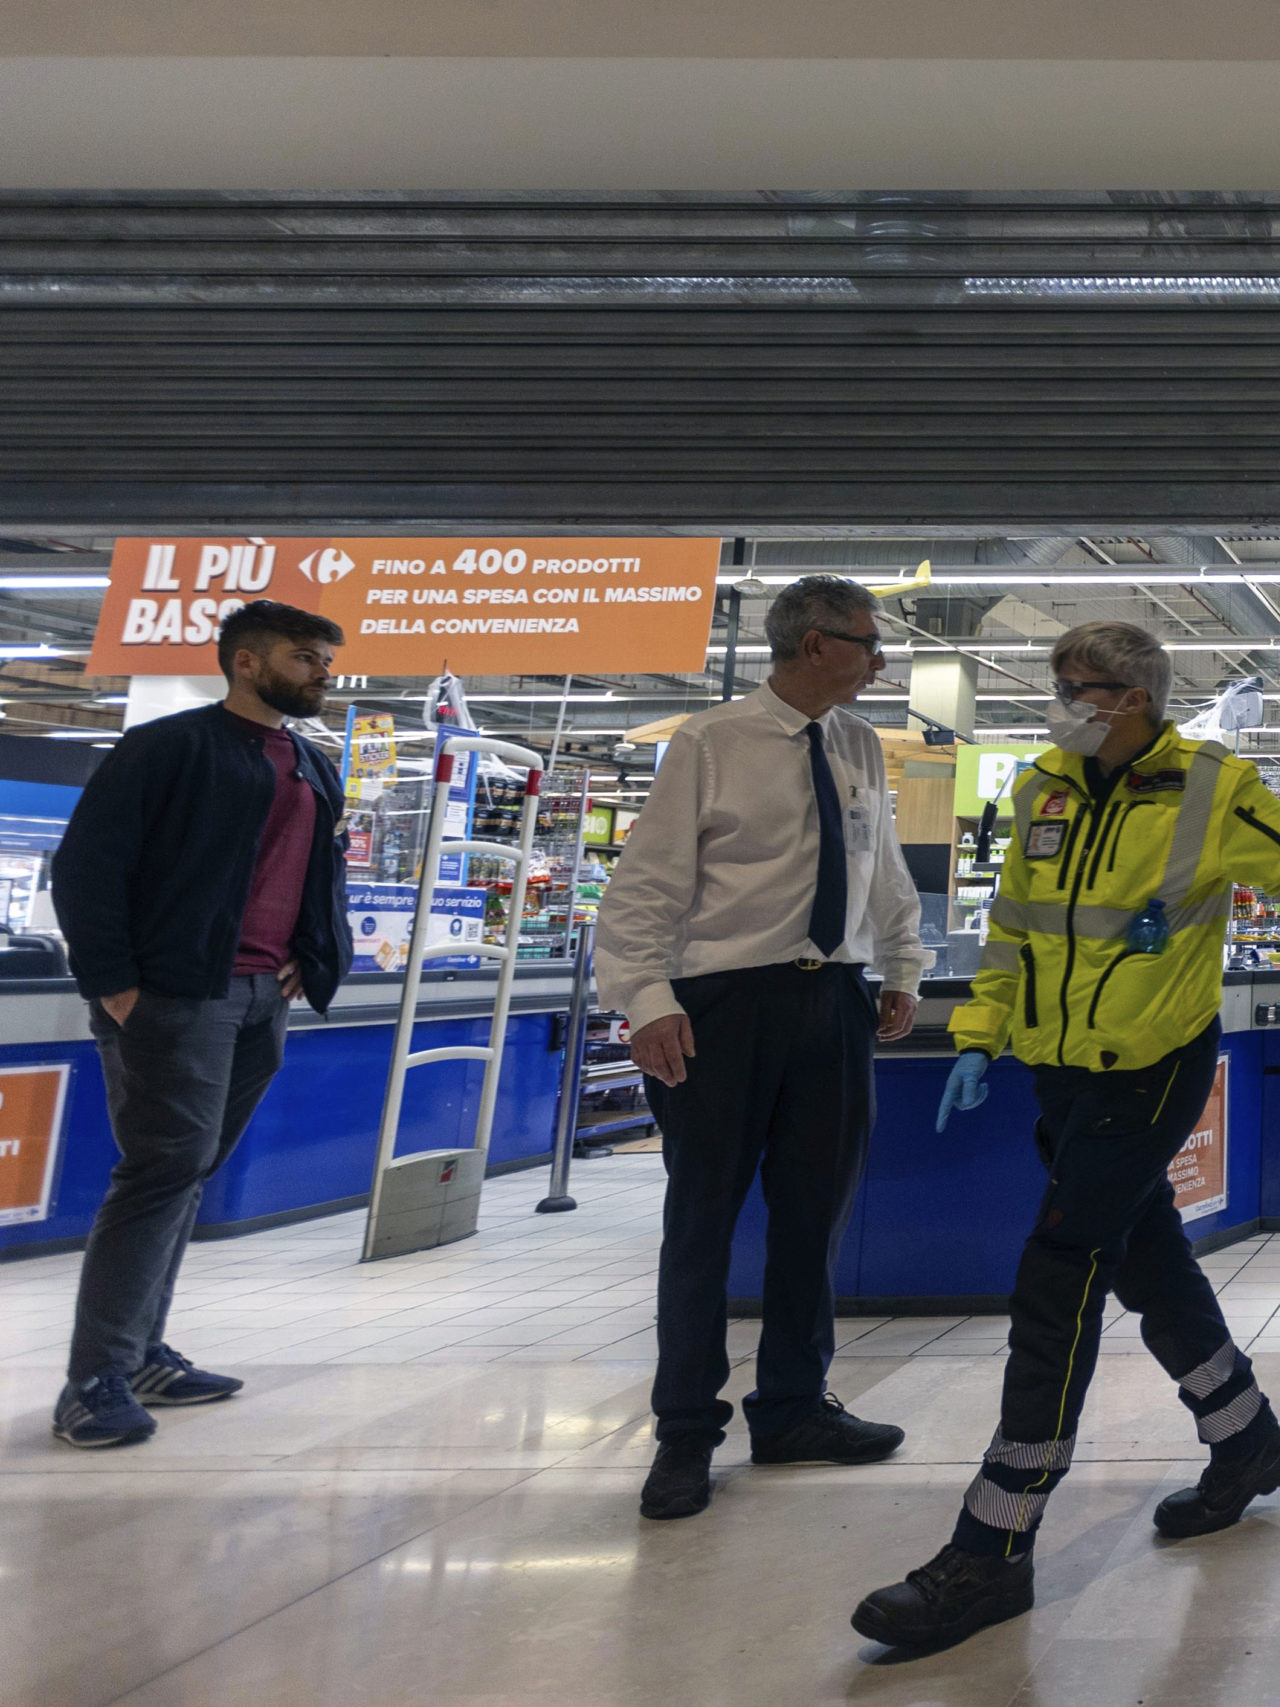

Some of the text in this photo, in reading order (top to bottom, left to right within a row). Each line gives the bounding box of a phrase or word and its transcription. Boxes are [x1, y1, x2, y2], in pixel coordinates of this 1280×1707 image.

[141, 537, 276, 592] IL PIÙ
[372, 549, 641, 575] FINO A 400 PRODOTTI
[366, 586, 702, 605] PER UNA SPESA CON IL MASSIMO
[121, 598, 246, 646] BASS
[360, 618, 580, 634] DELLA CONVENIENZA
[372, 894, 414, 908] sempre
[431, 897, 443, 907] uo
[445, 896, 482, 908] servizio
[1180, 1129, 1213, 1153] OTTI
[1176, 1153, 1197, 1168] SPESA
[1175, 1176, 1206, 1194] ENIENZA
